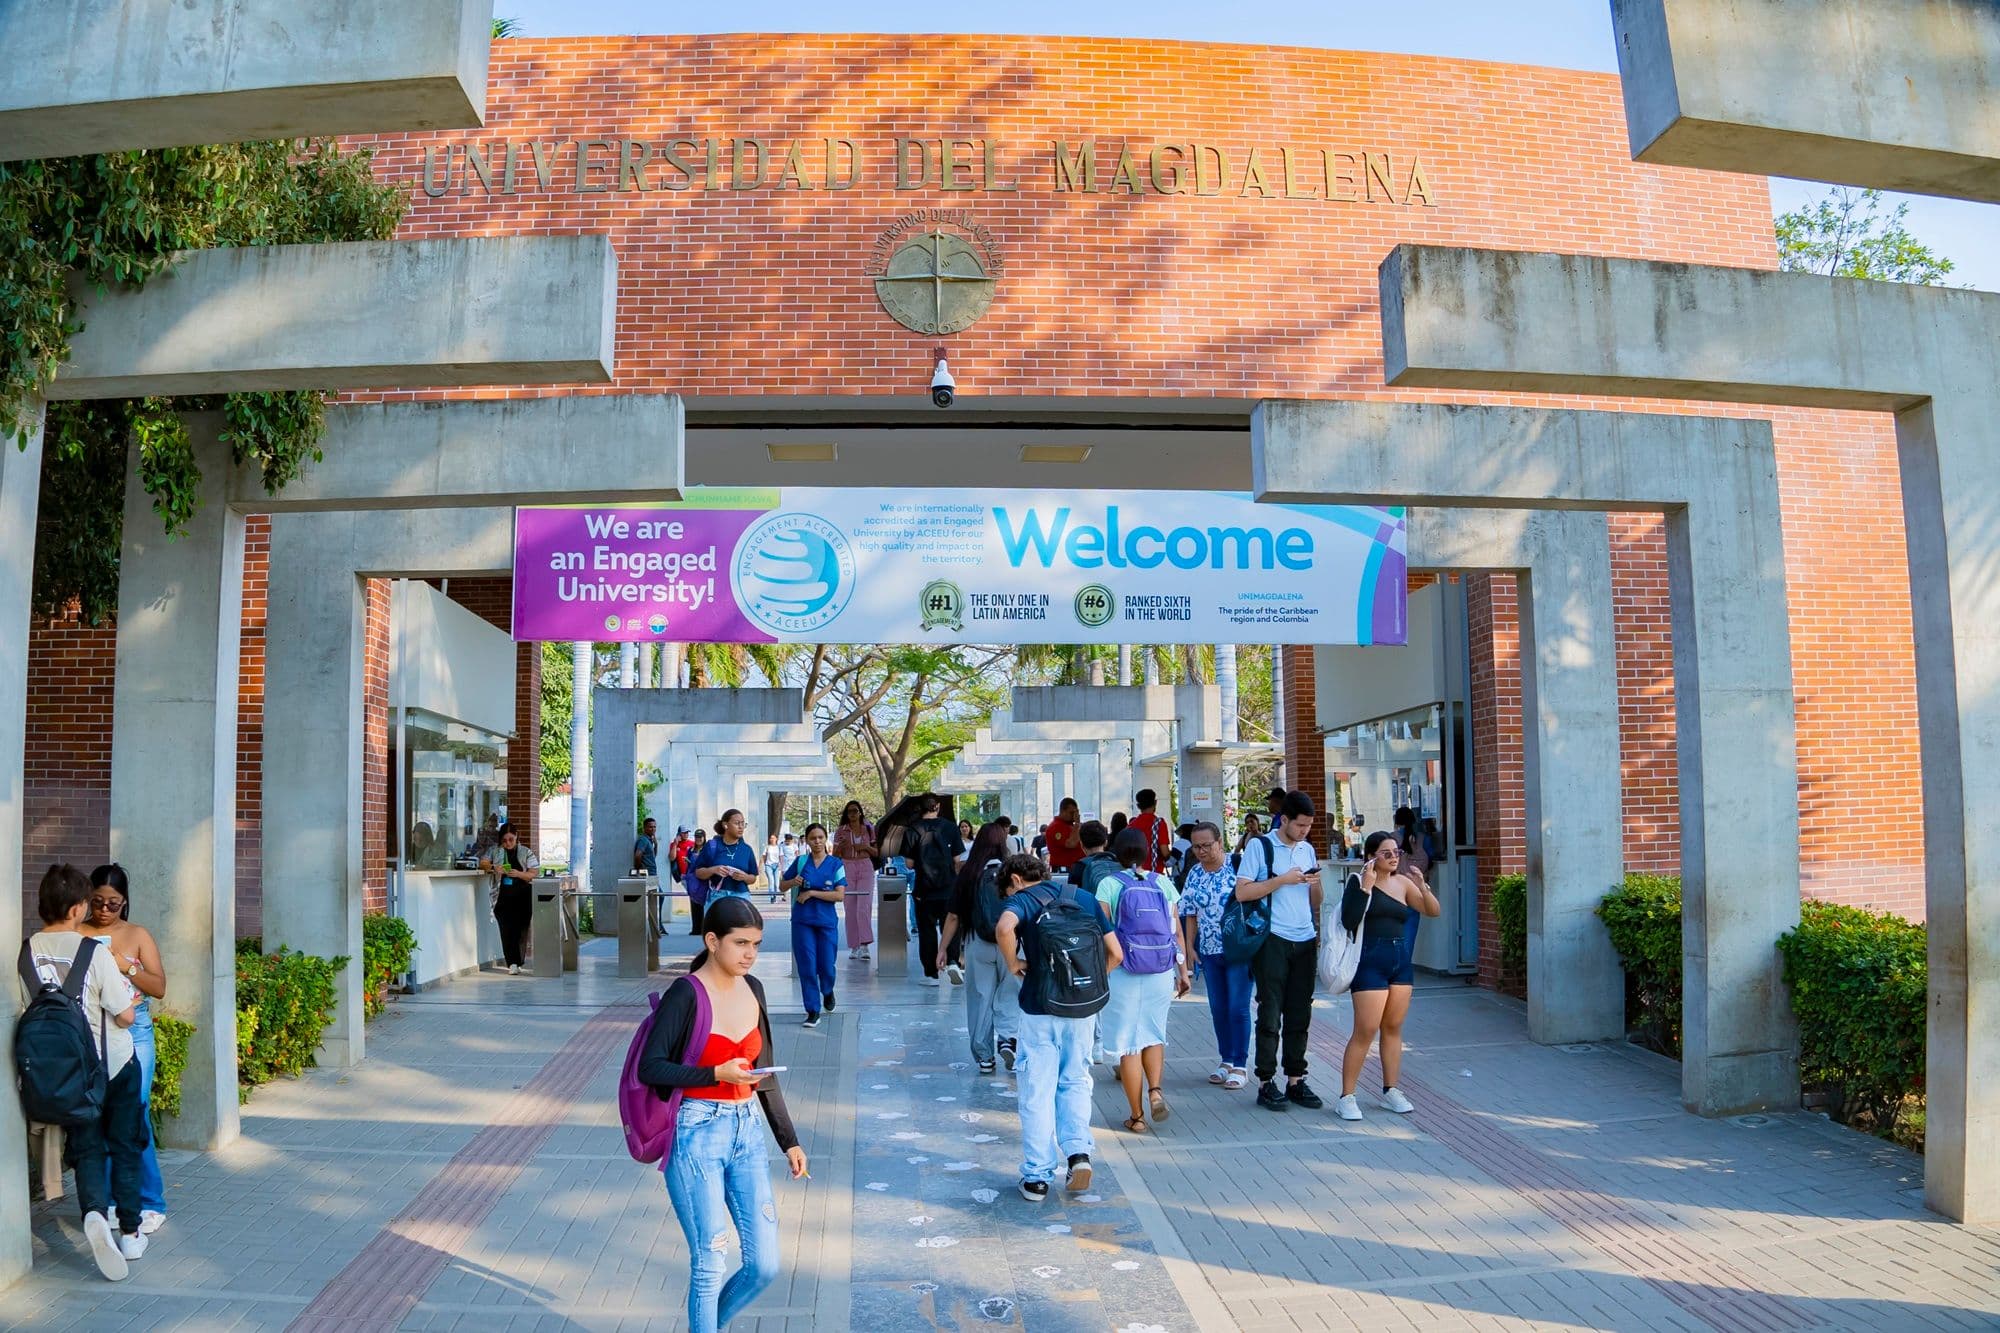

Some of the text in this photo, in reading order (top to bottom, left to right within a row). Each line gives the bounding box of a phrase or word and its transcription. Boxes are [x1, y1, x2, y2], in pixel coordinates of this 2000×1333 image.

[423, 137, 1439, 208] UNIVERSIDAD DEL MAGDALENA
[930, 208, 954, 224] DEL
[880, 504, 895, 512] We
[914, 504, 984, 515] internationally
[584, 514, 684, 540] We are
[863, 516, 984, 527] accredited as an Engaged
[853, 528, 984, 539] University by ACEEU for our
[991, 504, 1315, 571] Welcome
[743, 518, 850, 576] ENGAGEMENT ACCREDITED
[860, 541, 984, 553] high quality and impact on
[550, 545, 717, 580] an Engaged
[922, 554, 983, 565] the territory.
[558, 576, 715, 611] University!
[970, 593, 1050, 606] THE ONLY ONE IN
[1237, 592, 1304, 601] UNIMAGDALENA
[929, 594, 953, 611] #1
[1083, 595, 1106, 609] #6
[1125, 595, 1191, 608] RANKED SIXTH
[973, 607, 1046, 620] LATIN AMERICA
[1125, 608, 1191, 620] IN THE WORLD
[1218, 606, 1319, 616] The pride of the Caribbean
[774, 616, 817, 628] ACEEU
[1230, 615, 1309, 625] region and Colombia
